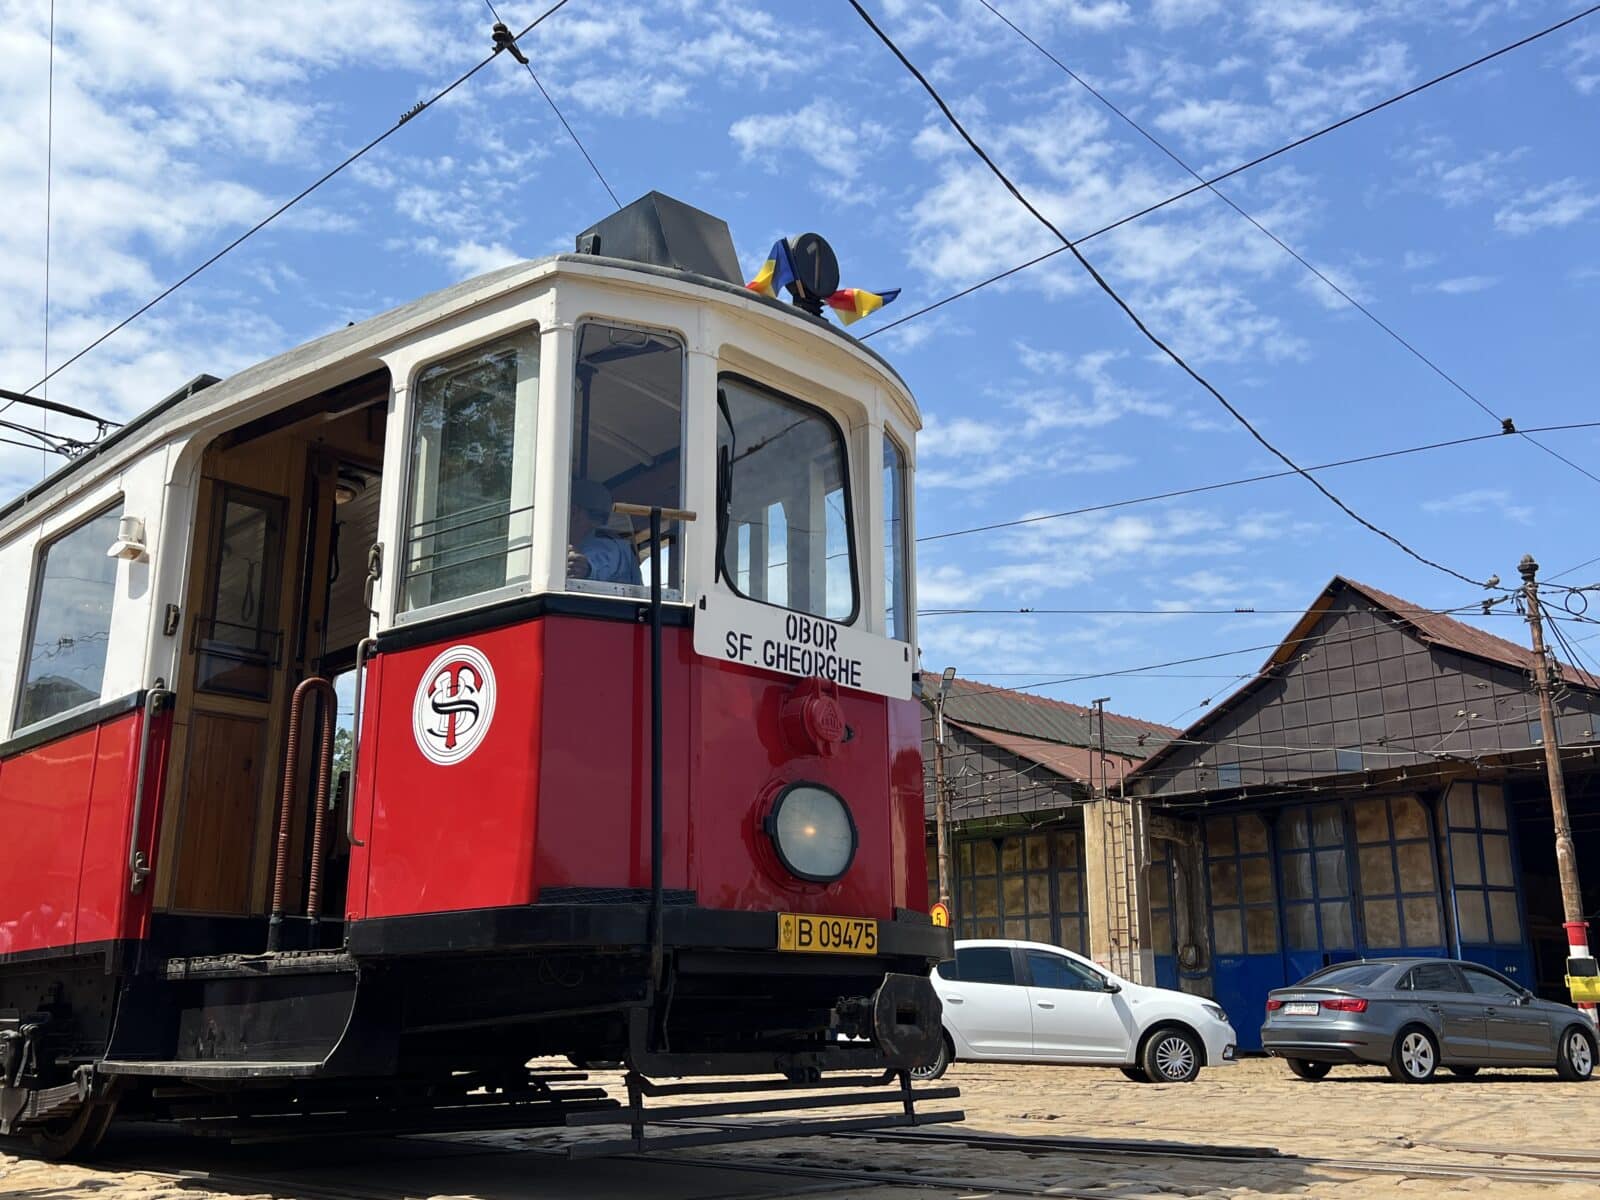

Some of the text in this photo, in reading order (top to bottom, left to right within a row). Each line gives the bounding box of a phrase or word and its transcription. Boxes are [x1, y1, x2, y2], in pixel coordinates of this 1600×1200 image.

[786, 614, 838, 652] OBOR
[725, 631, 862, 687] SF. GHEORGHE
[798, 919, 876, 950] B 09475
